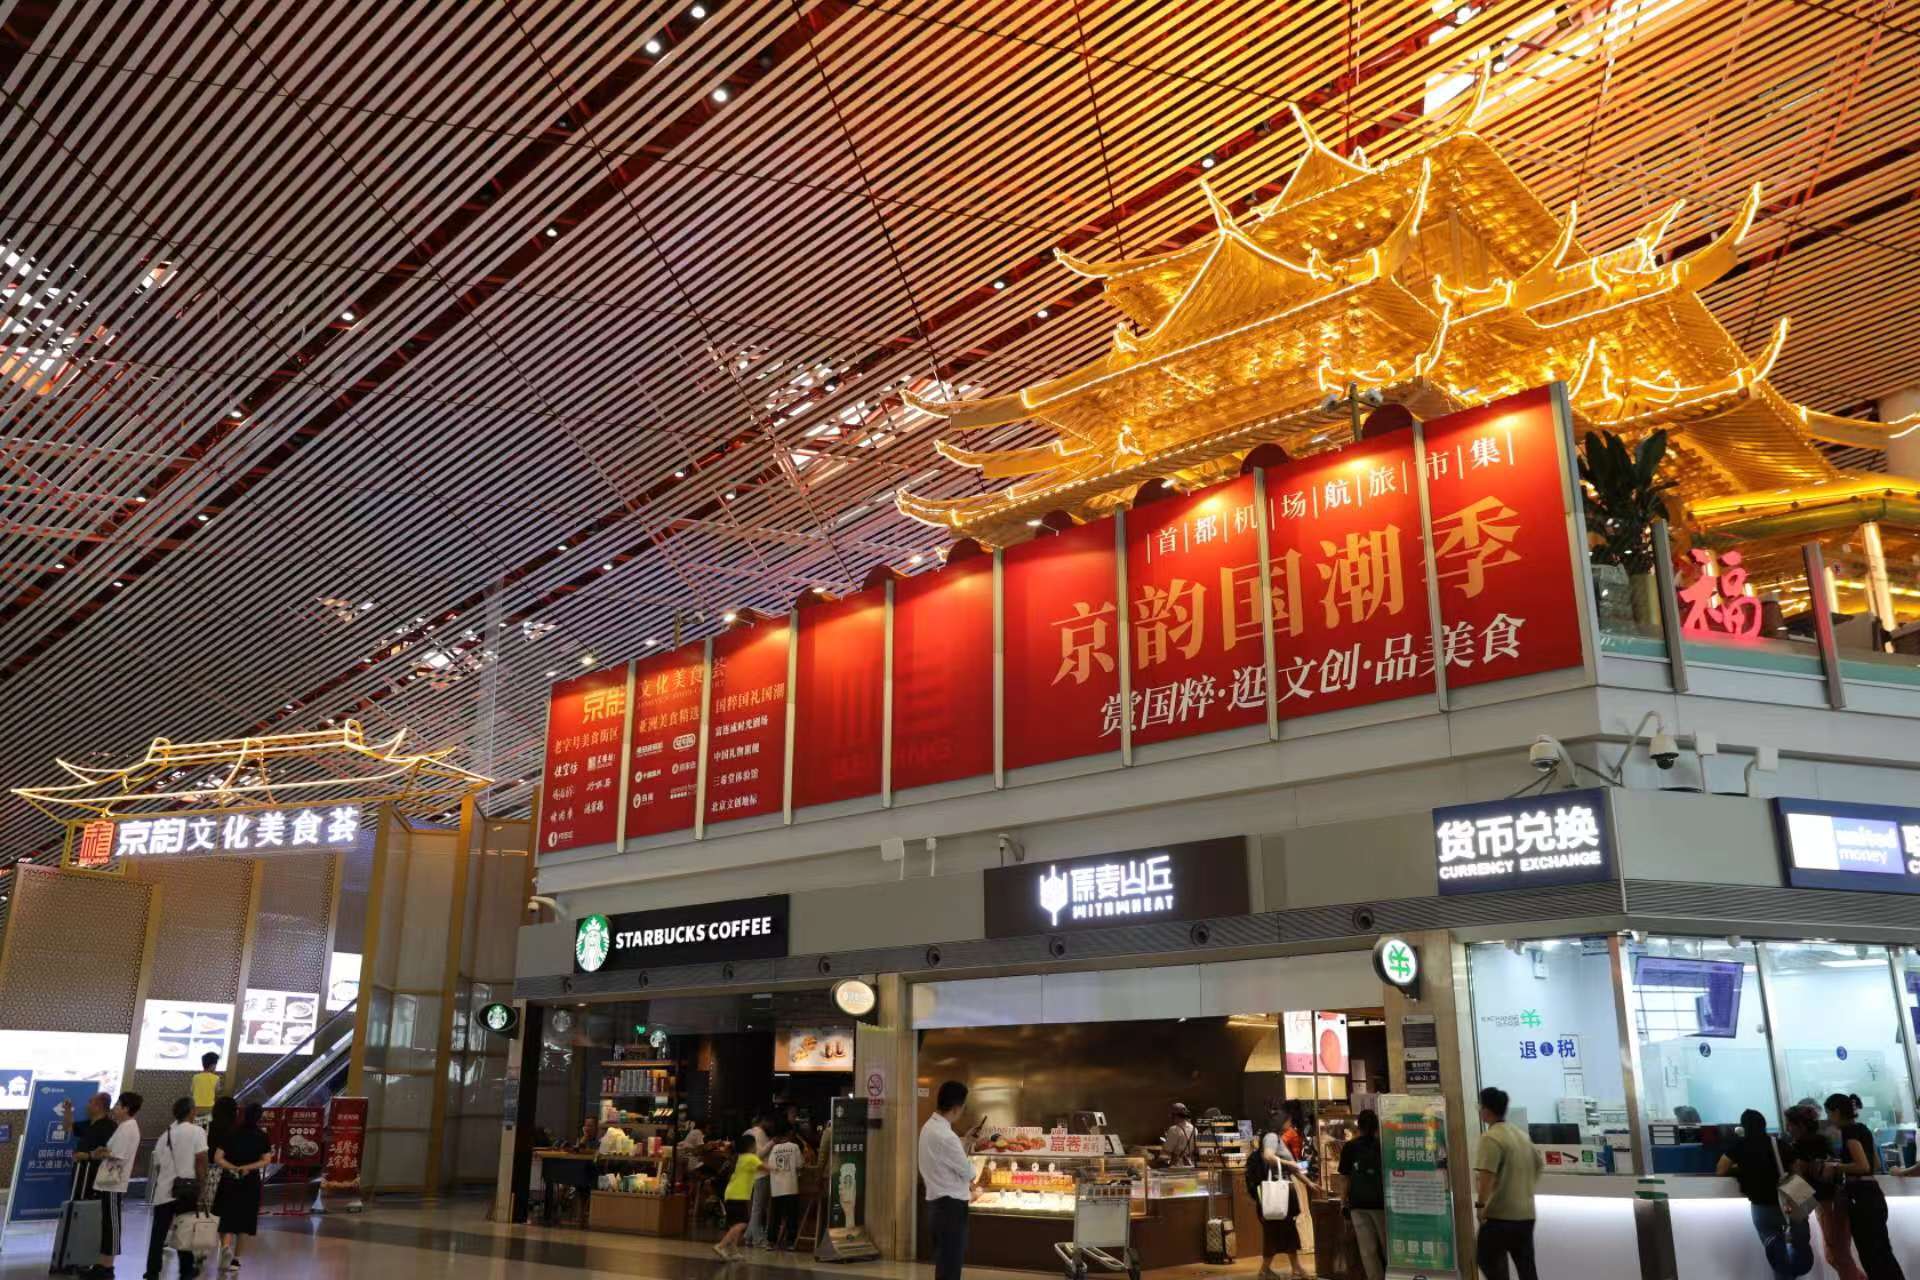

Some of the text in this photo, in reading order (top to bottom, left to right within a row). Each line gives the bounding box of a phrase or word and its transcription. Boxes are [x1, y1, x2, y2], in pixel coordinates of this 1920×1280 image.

[1050, 496, 1522, 686] 京韵国潮季
[115, 807, 358, 856] 京韵文化美食荟
[1437, 805, 1600, 863] 货币兑换
[1070, 855, 1173, 902] 原麦山丘
[1439, 851, 1602, 880] CURRENCY EXCHANGE
[615, 916, 772, 950] STARBUCKS COFFEE
